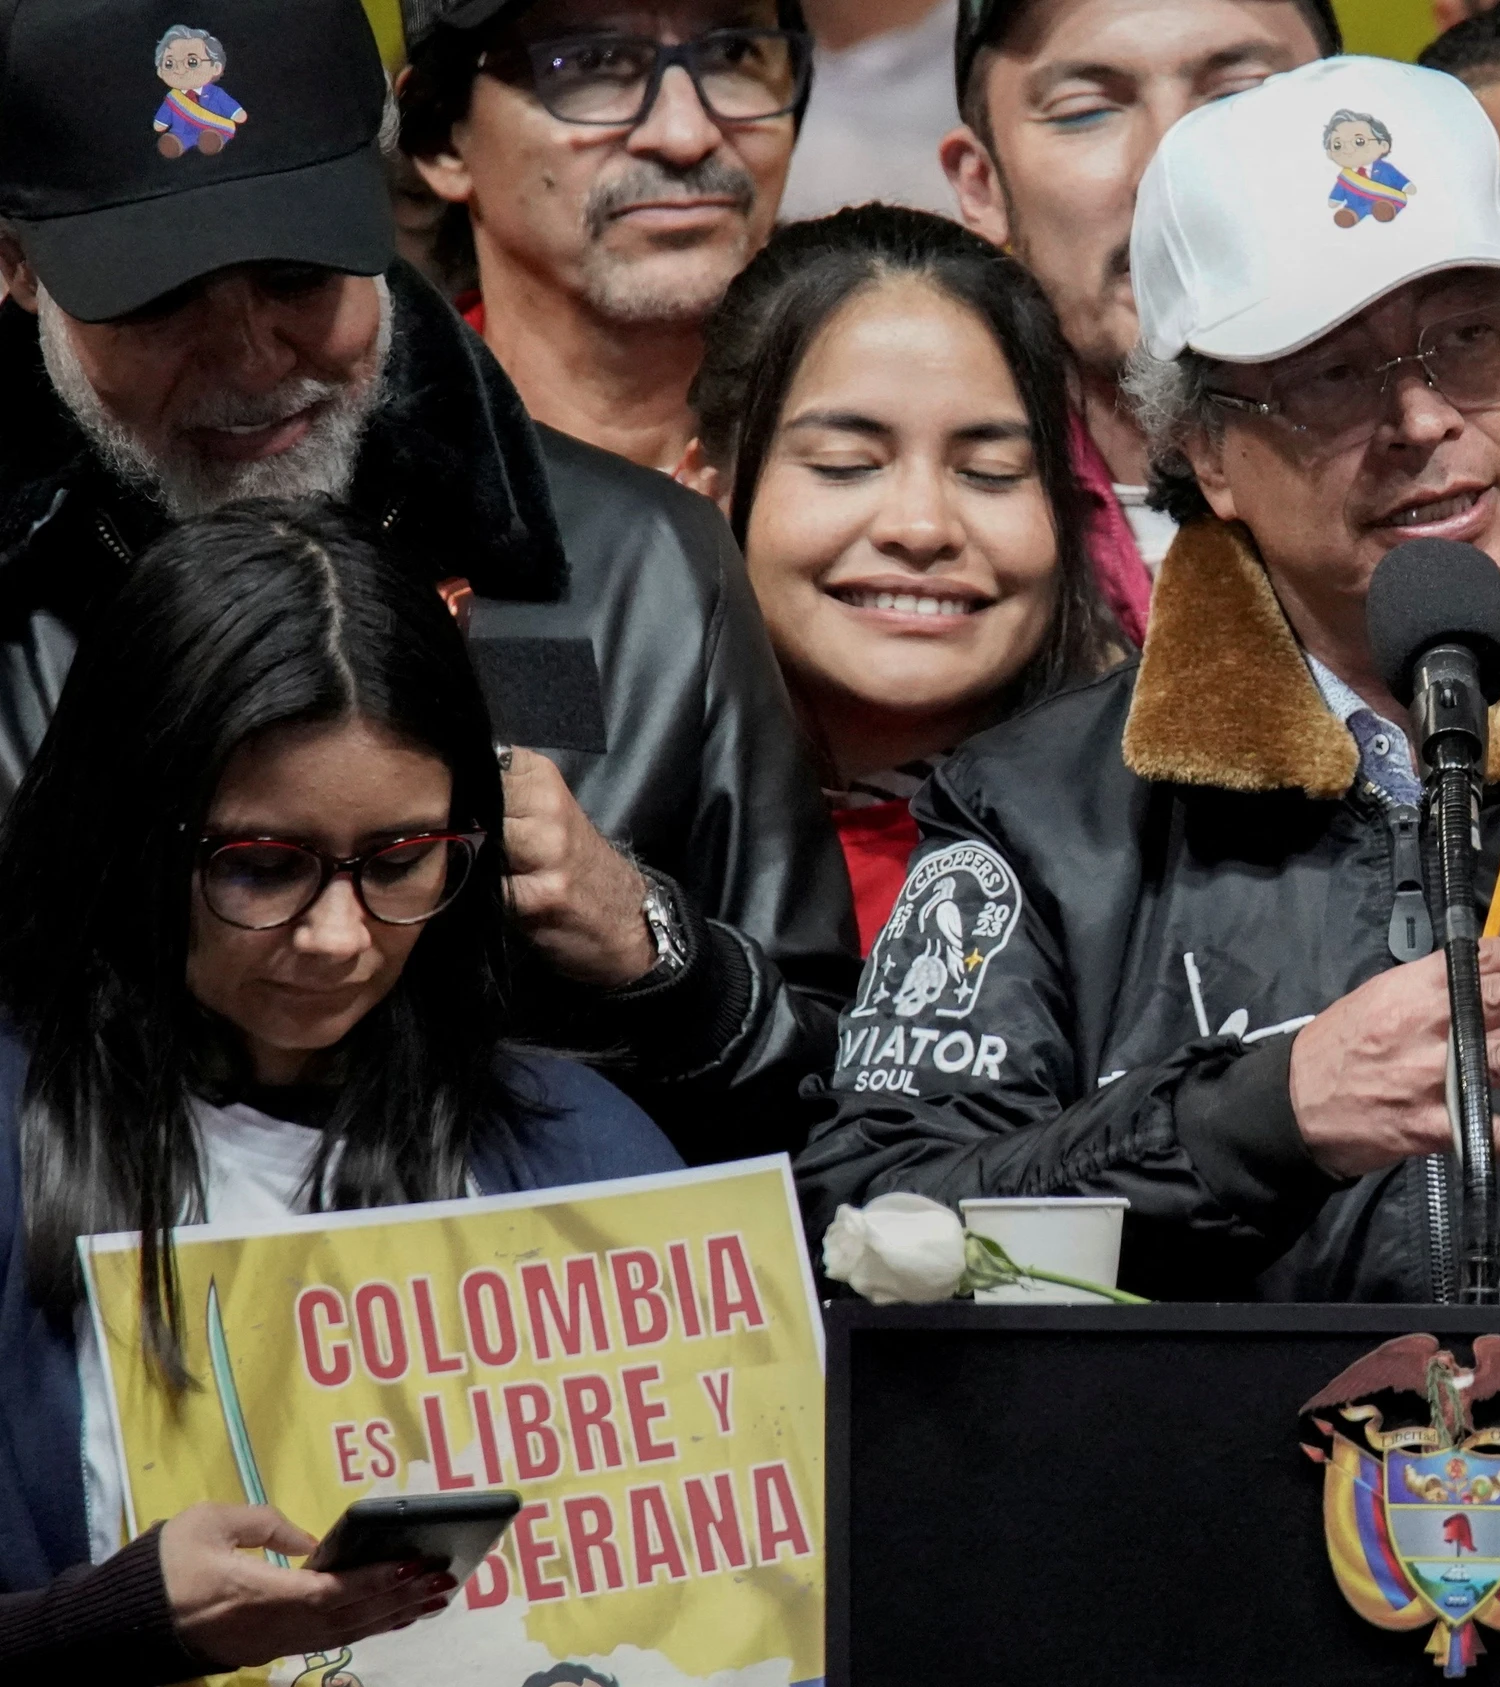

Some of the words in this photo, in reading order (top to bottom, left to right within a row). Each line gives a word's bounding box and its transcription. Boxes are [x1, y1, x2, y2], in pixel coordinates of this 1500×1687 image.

[914, 850, 1001, 890] CHOPPERS
[971, 918, 1003, 938] 23
[977, 900, 1011, 923] 20
[836, 1025, 1008, 1081] VIATOR
[853, 1068, 921, 1097] SOUL
[297, 1233, 766, 1388] COLOMBIA
[334, 1420, 398, 1483] ES
[420, 1364, 677, 1492] LIBRE
[702, 1371, 732, 1434] Y
[1380, 1429, 1438, 1449] Libertad
[463, 1462, 812, 1612] BERANA
